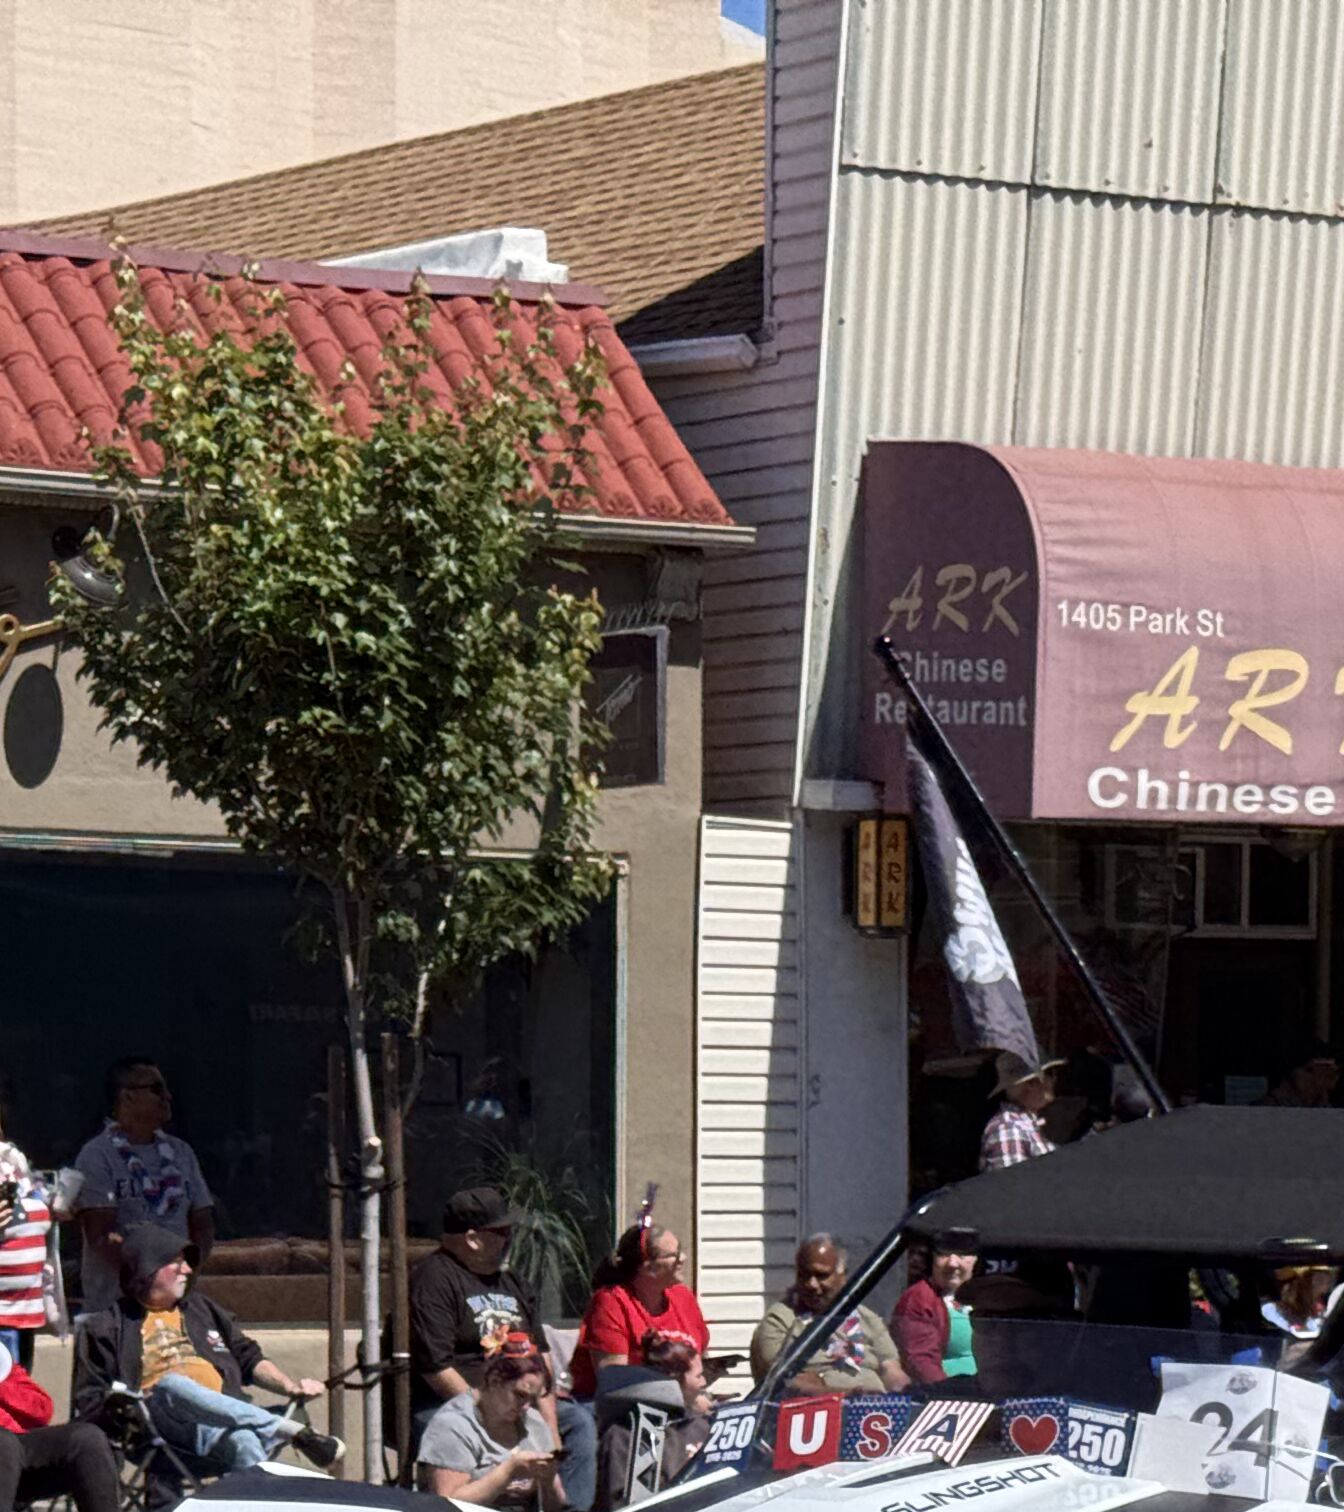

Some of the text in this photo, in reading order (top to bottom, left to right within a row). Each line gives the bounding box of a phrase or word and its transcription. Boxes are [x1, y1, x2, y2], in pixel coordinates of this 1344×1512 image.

[880, 562, 1029, 637] ARK
[1057, 600, 1225, 637] 1405 Park St
[874, 692, 1028, 727] Retaurant
[1087, 766, 1335, 816] Chinese
[703, 1416, 756, 1455] 250
[1067, 1420, 1127, 1467] 250
[1189, 1401, 1281, 1468] 24
